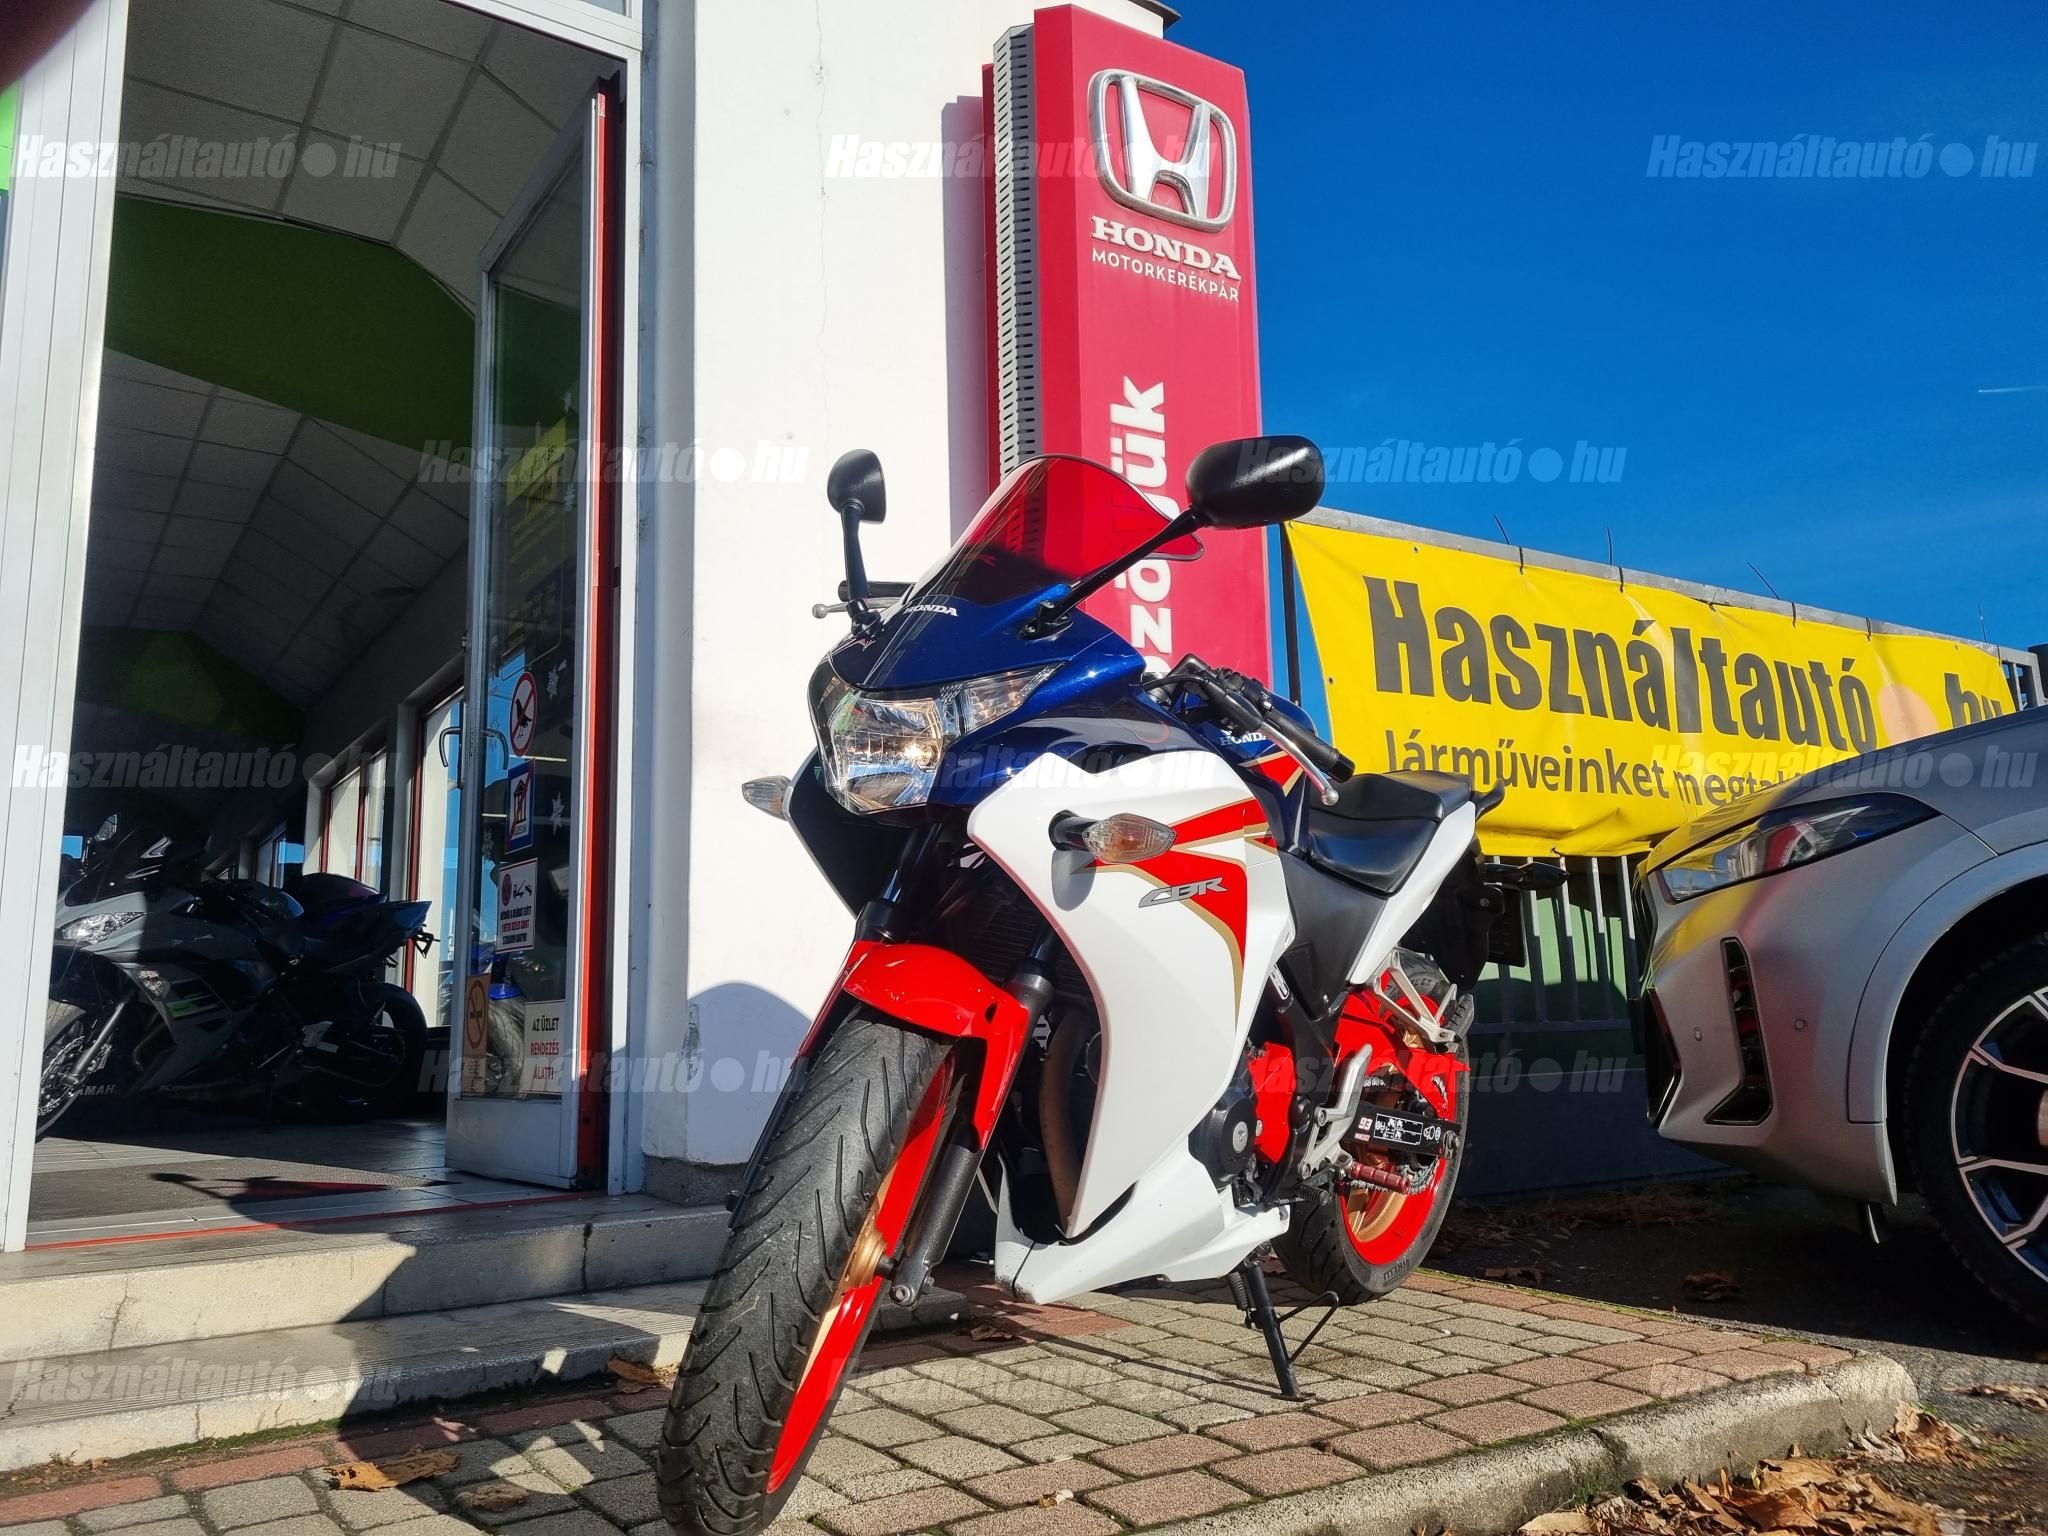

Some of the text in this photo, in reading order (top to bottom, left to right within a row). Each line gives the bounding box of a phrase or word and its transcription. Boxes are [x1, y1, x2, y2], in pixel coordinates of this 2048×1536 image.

[1091, 215, 1242, 281] HONDA
[1091, 247, 1240, 302] MOTORKERÉKPÁR
[1362, 575, 1879, 754] Használtautó
[1138, 876, 1229, 909] CBR
